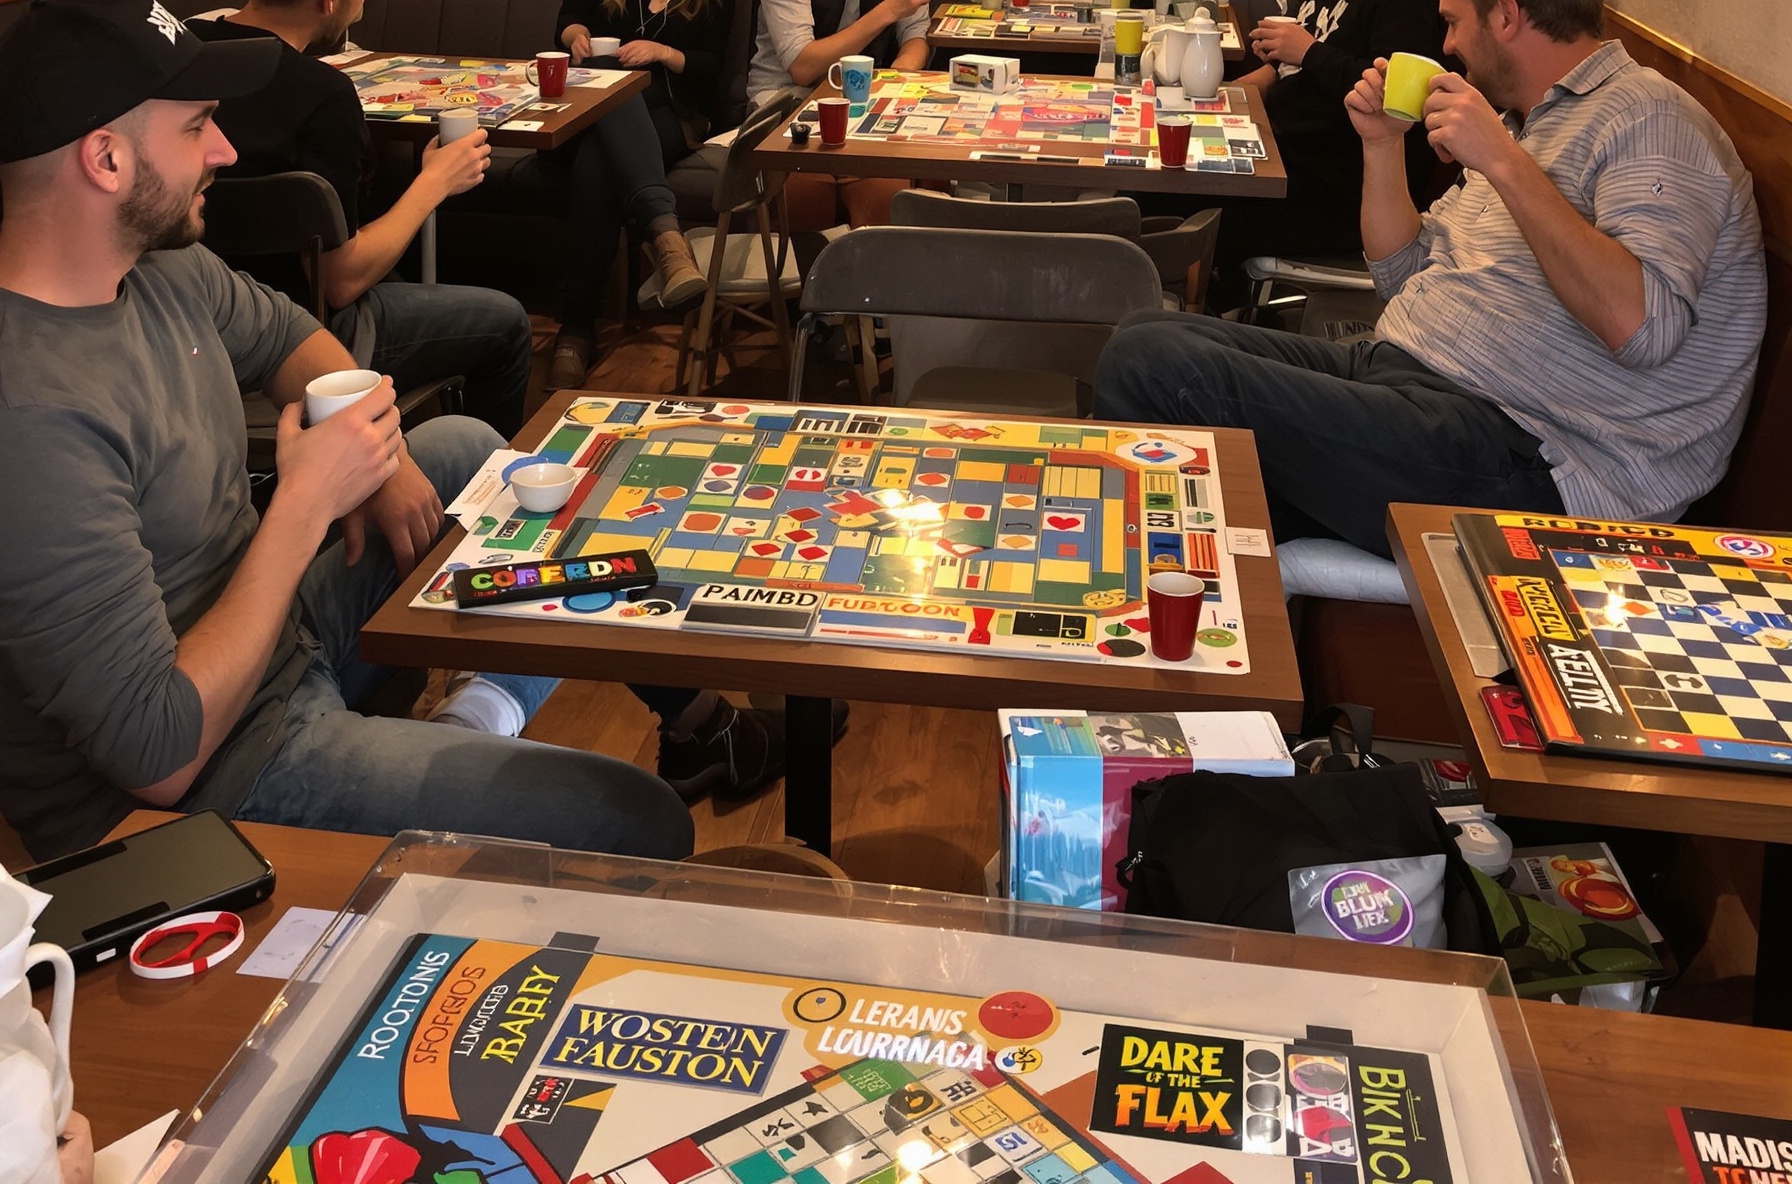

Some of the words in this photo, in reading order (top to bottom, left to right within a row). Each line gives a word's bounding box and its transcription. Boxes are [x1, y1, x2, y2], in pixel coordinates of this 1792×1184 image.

[553, 1036, 764, 1087] FAUSTON
[1121, 1036, 1224, 1078] DARE
[1115, 1083, 1235, 1137] FLAX
